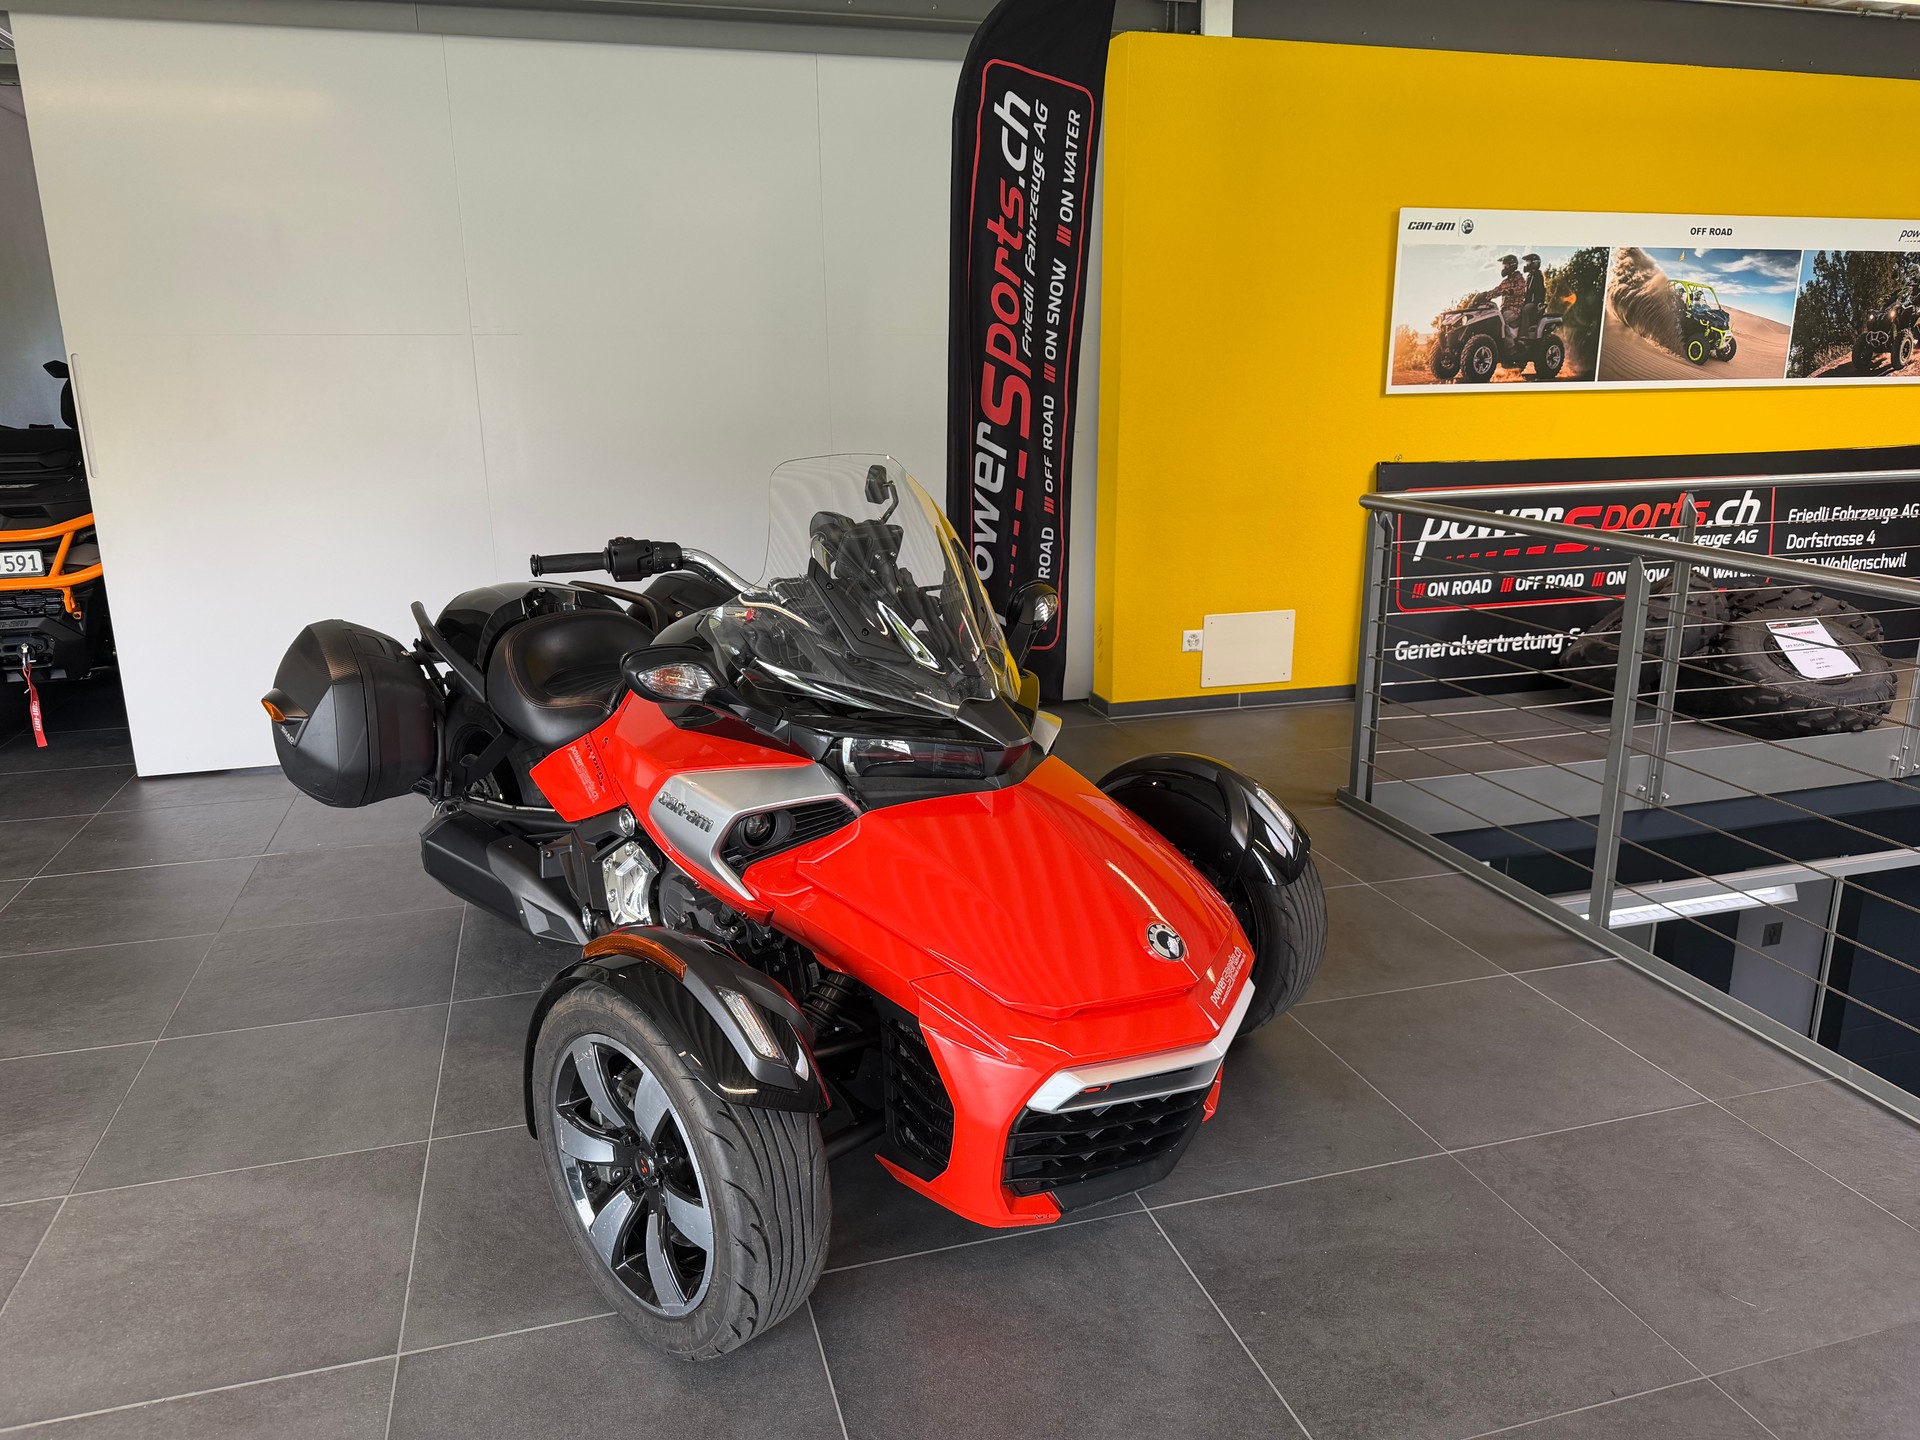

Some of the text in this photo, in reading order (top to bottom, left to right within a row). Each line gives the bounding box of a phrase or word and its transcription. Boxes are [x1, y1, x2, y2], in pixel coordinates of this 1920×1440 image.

[1022, 99, 1049, 357] Friedli Fahrzeuge AG
[1407, 221, 1456, 231] can-am
[1690, 227, 1733, 236] OFF ROAD
[1038, 109, 1081, 579] ROAD OFF ROAD ON SNOW ON WATER
[1788, 503, 1920, 524] Friedli Fahrzeuge AG
[1734, 529, 1760, 545] AG
[1786, 530, 1876, 550] Dorfstrasse 4
[3, 554, 39, 573] 591
[1821, 552, 1907, 570] Wohlenschwil
[1427, 581, 1449, 598] ON
[1452, 579, 1492, 596] ROAD
[1515, 575, 1543, 592] OFF
[1545, 572, 1584, 590] ROAD
[1606, 570, 1627, 586] ON
[1395, 632, 1563, 661] Generalvertretung
[658, 791, 716, 833] can-am
